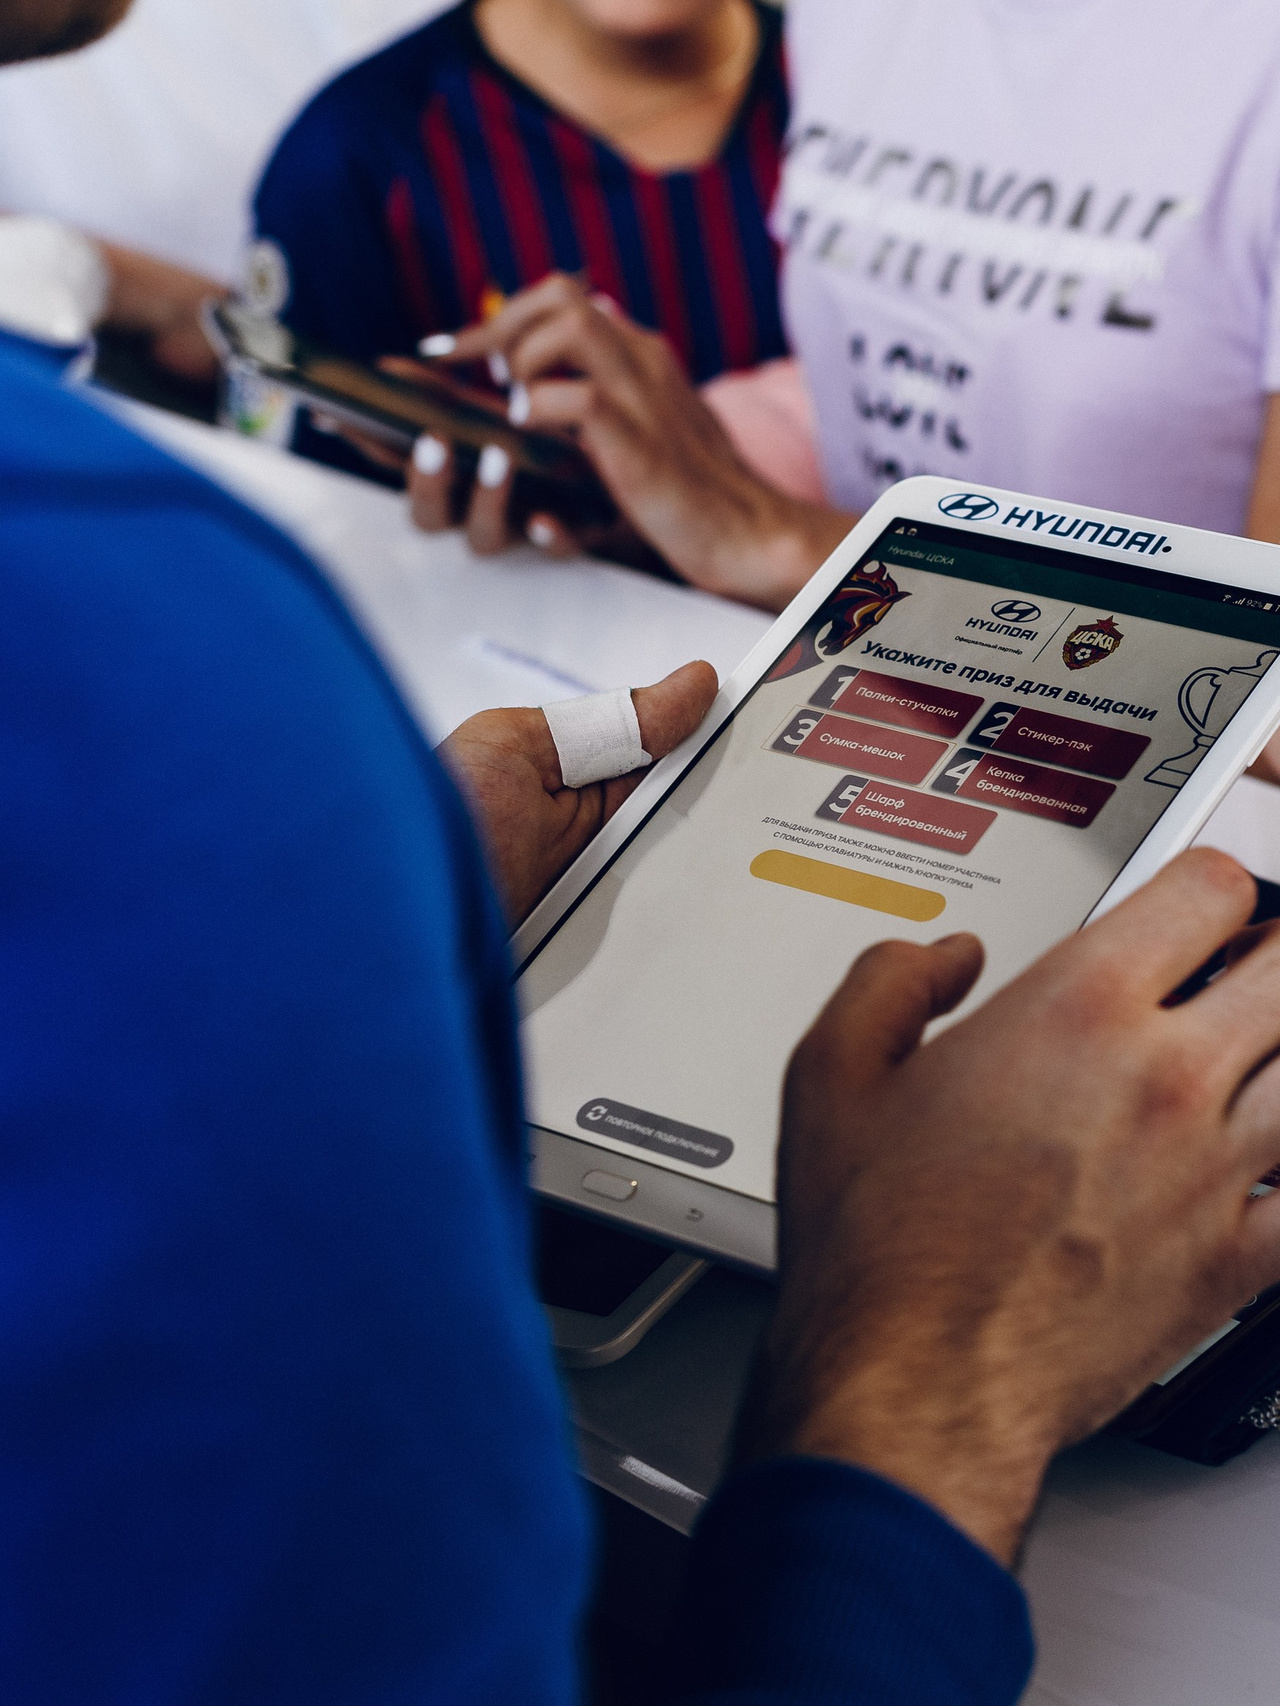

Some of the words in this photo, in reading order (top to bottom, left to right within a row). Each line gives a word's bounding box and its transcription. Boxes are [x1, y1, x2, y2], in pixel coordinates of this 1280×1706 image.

[1001, 506, 1168, 555] HYUNDAI
[888, 546, 926, 559] Hyundai
[926, 553, 955, 566] ЦСКА
[965, 617, 1039, 641] HYUNDAI
[1070, 630, 1114, 651] ЦСКА
[830, 675, 855, 701] 1
[860, 640, 957, 674] Укажите
[957, 665, 1014, 688] приз
[1014, 679, 1064, 699] для
[1063, 691, 1158, 722] выдачи
[855, 686, 959, 718] Палки-стучалки
[783, 718, 817, 746] 3
[979, 711, 1014, 739] 2
[1017, 726, 1093, 752] Стикер-пэк
[819, 733, 906, 761] Сумка-мешок
[945, 759, 980, 786] 4
[986, 765, 1025, 783] Кепка
[828, 786, 862, 814] 5
[865, 791, 905, 810] Шарф
[976, 779, 1088, 815] брендированная
[855, 804, 968, 841] брендированный
[761, 816, 780, 826] ДЛЯ
[779, 820, 812, 834] ВЫДАЧИ
[812, 829, 837, 841] ПРИЗА
[838, 836, 864, 848] ТАКЖЕ
[863, 843, 896, 856] МОЖНО
[895, 851, 926, 864] ВВЕСТИ
[926, 860, 955, 871] НОМЕР
[955, 867, 1001, 884] УЧАСТНИКА
[779, 833, 824, 849] ПОМОЩЬЮ
[823, 845, 874, 862] КЛАВИАТУРЫ
[881, 860, 914, 874] НАЖАТЬ
[914, 869, 947, 882] КНОПКУ
[946, 878, 973, 890] ПРИЗА
